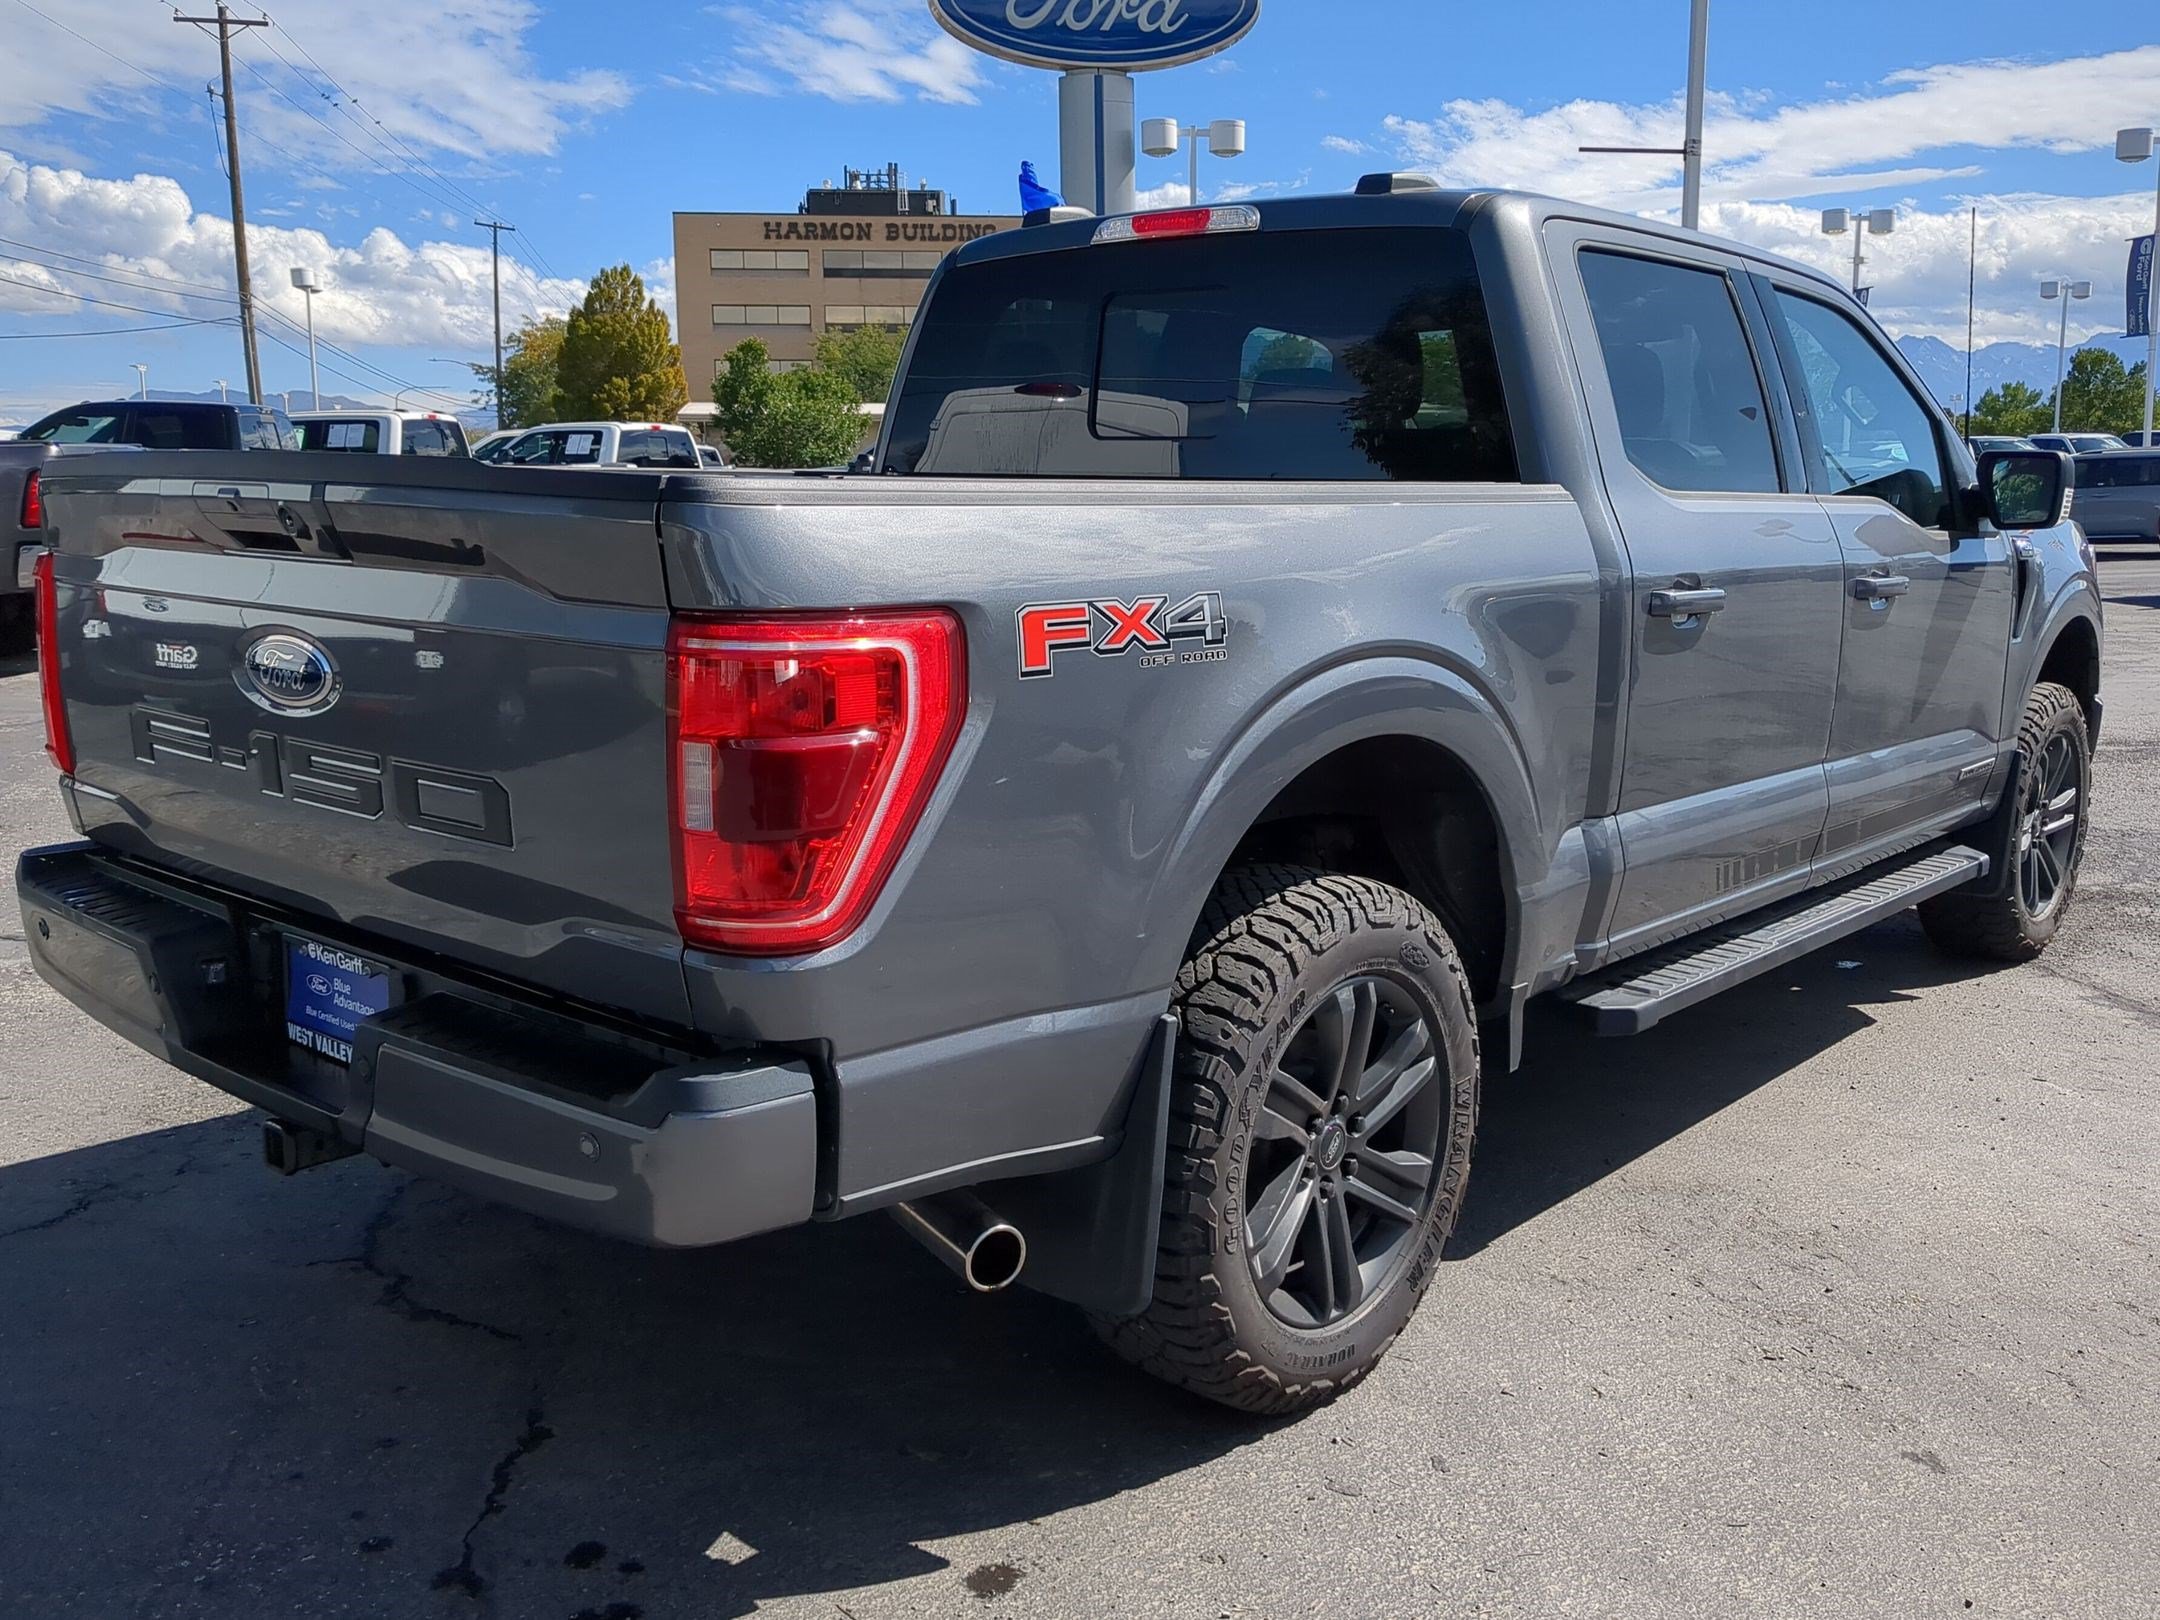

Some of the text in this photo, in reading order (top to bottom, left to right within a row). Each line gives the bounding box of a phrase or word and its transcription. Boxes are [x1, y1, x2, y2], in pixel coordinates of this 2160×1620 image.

[763, 221, 997, 241] HARMON BUILDING
[2136, 256, 2145, 281] Ford
[1014, 590, 1229, 680] FX4
[260, 648, 307, 691] Ford
[1139, 649, 1228, 668] OFF ROAD
[129, 703, 516, 851] F-150
[316, 945, 337, 967] Ken
[333, 977, 352, 995] Blue
[333, 992, 375, 1016] Advantage
[305, 1005, 355, 1031] Blue Certified Used
[287, 1021, 353, 1064] WEST VALLEY
[1406, 1076, 1473, 1293] WRANGLER
